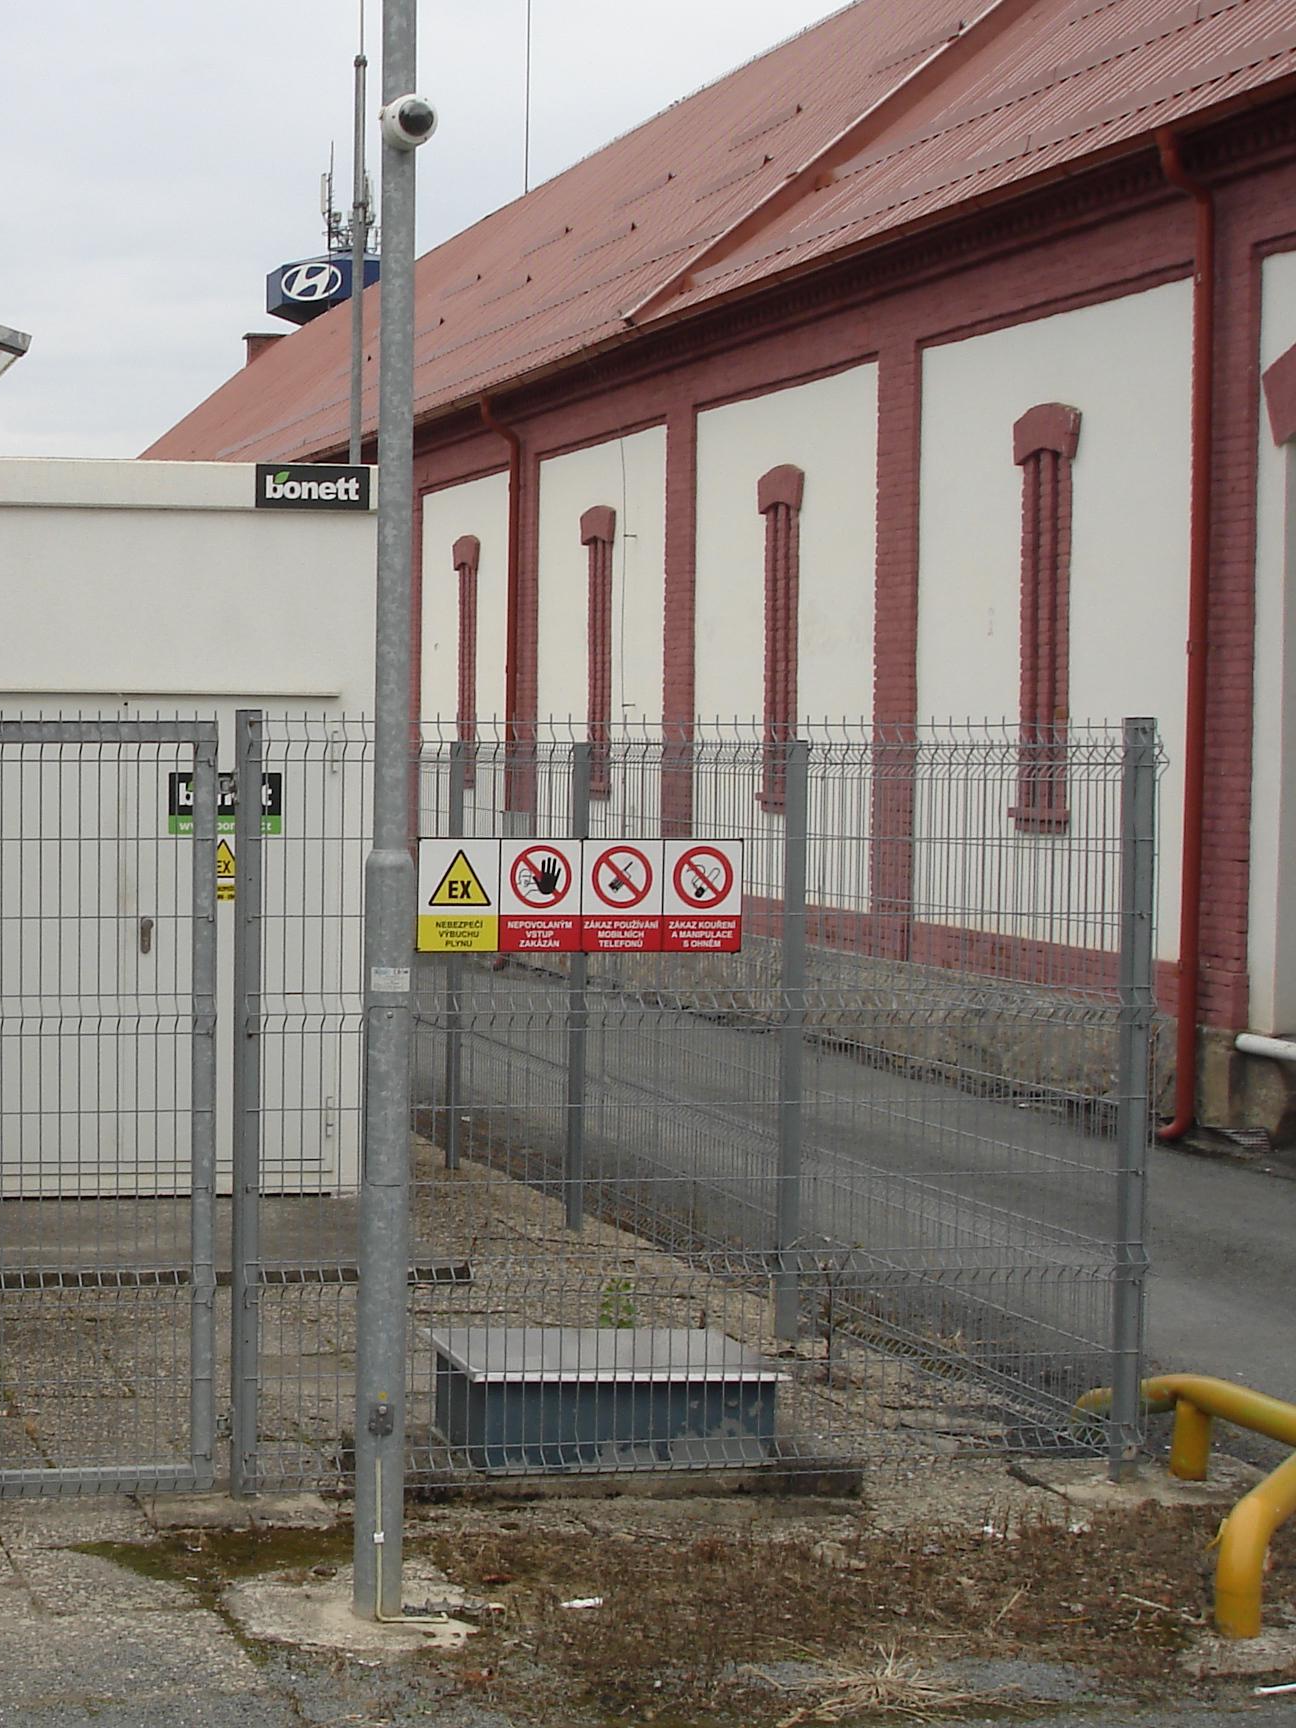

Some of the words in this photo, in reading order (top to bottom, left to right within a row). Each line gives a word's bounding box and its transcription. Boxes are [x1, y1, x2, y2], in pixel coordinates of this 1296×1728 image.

[265, 474, 360, 501] bonett
[448, 880, 472, 899] EX
[435, 920, 483, 928] NEBEZPEČÍ
[507, 920, 573, 929] NEPOVOLANÝM
[583, 919, 612, 929] ZÁKAZ
[668, 920, 696, 929] ZÁKAZ
[698, 920, 736, 929] KOUŘENÍ
[438, 929, 480, 938] VÝBUCHU
[525, 930, 554, 938] VSTUP
[597, 930, 644, 938] MOBILNÍCH
[671, 930, 678, 938] A
[679, 930, 733, 938] MANIPULACE
[445, 939, 473, 947] PLYNU
[682, 939, 689, 947] S
